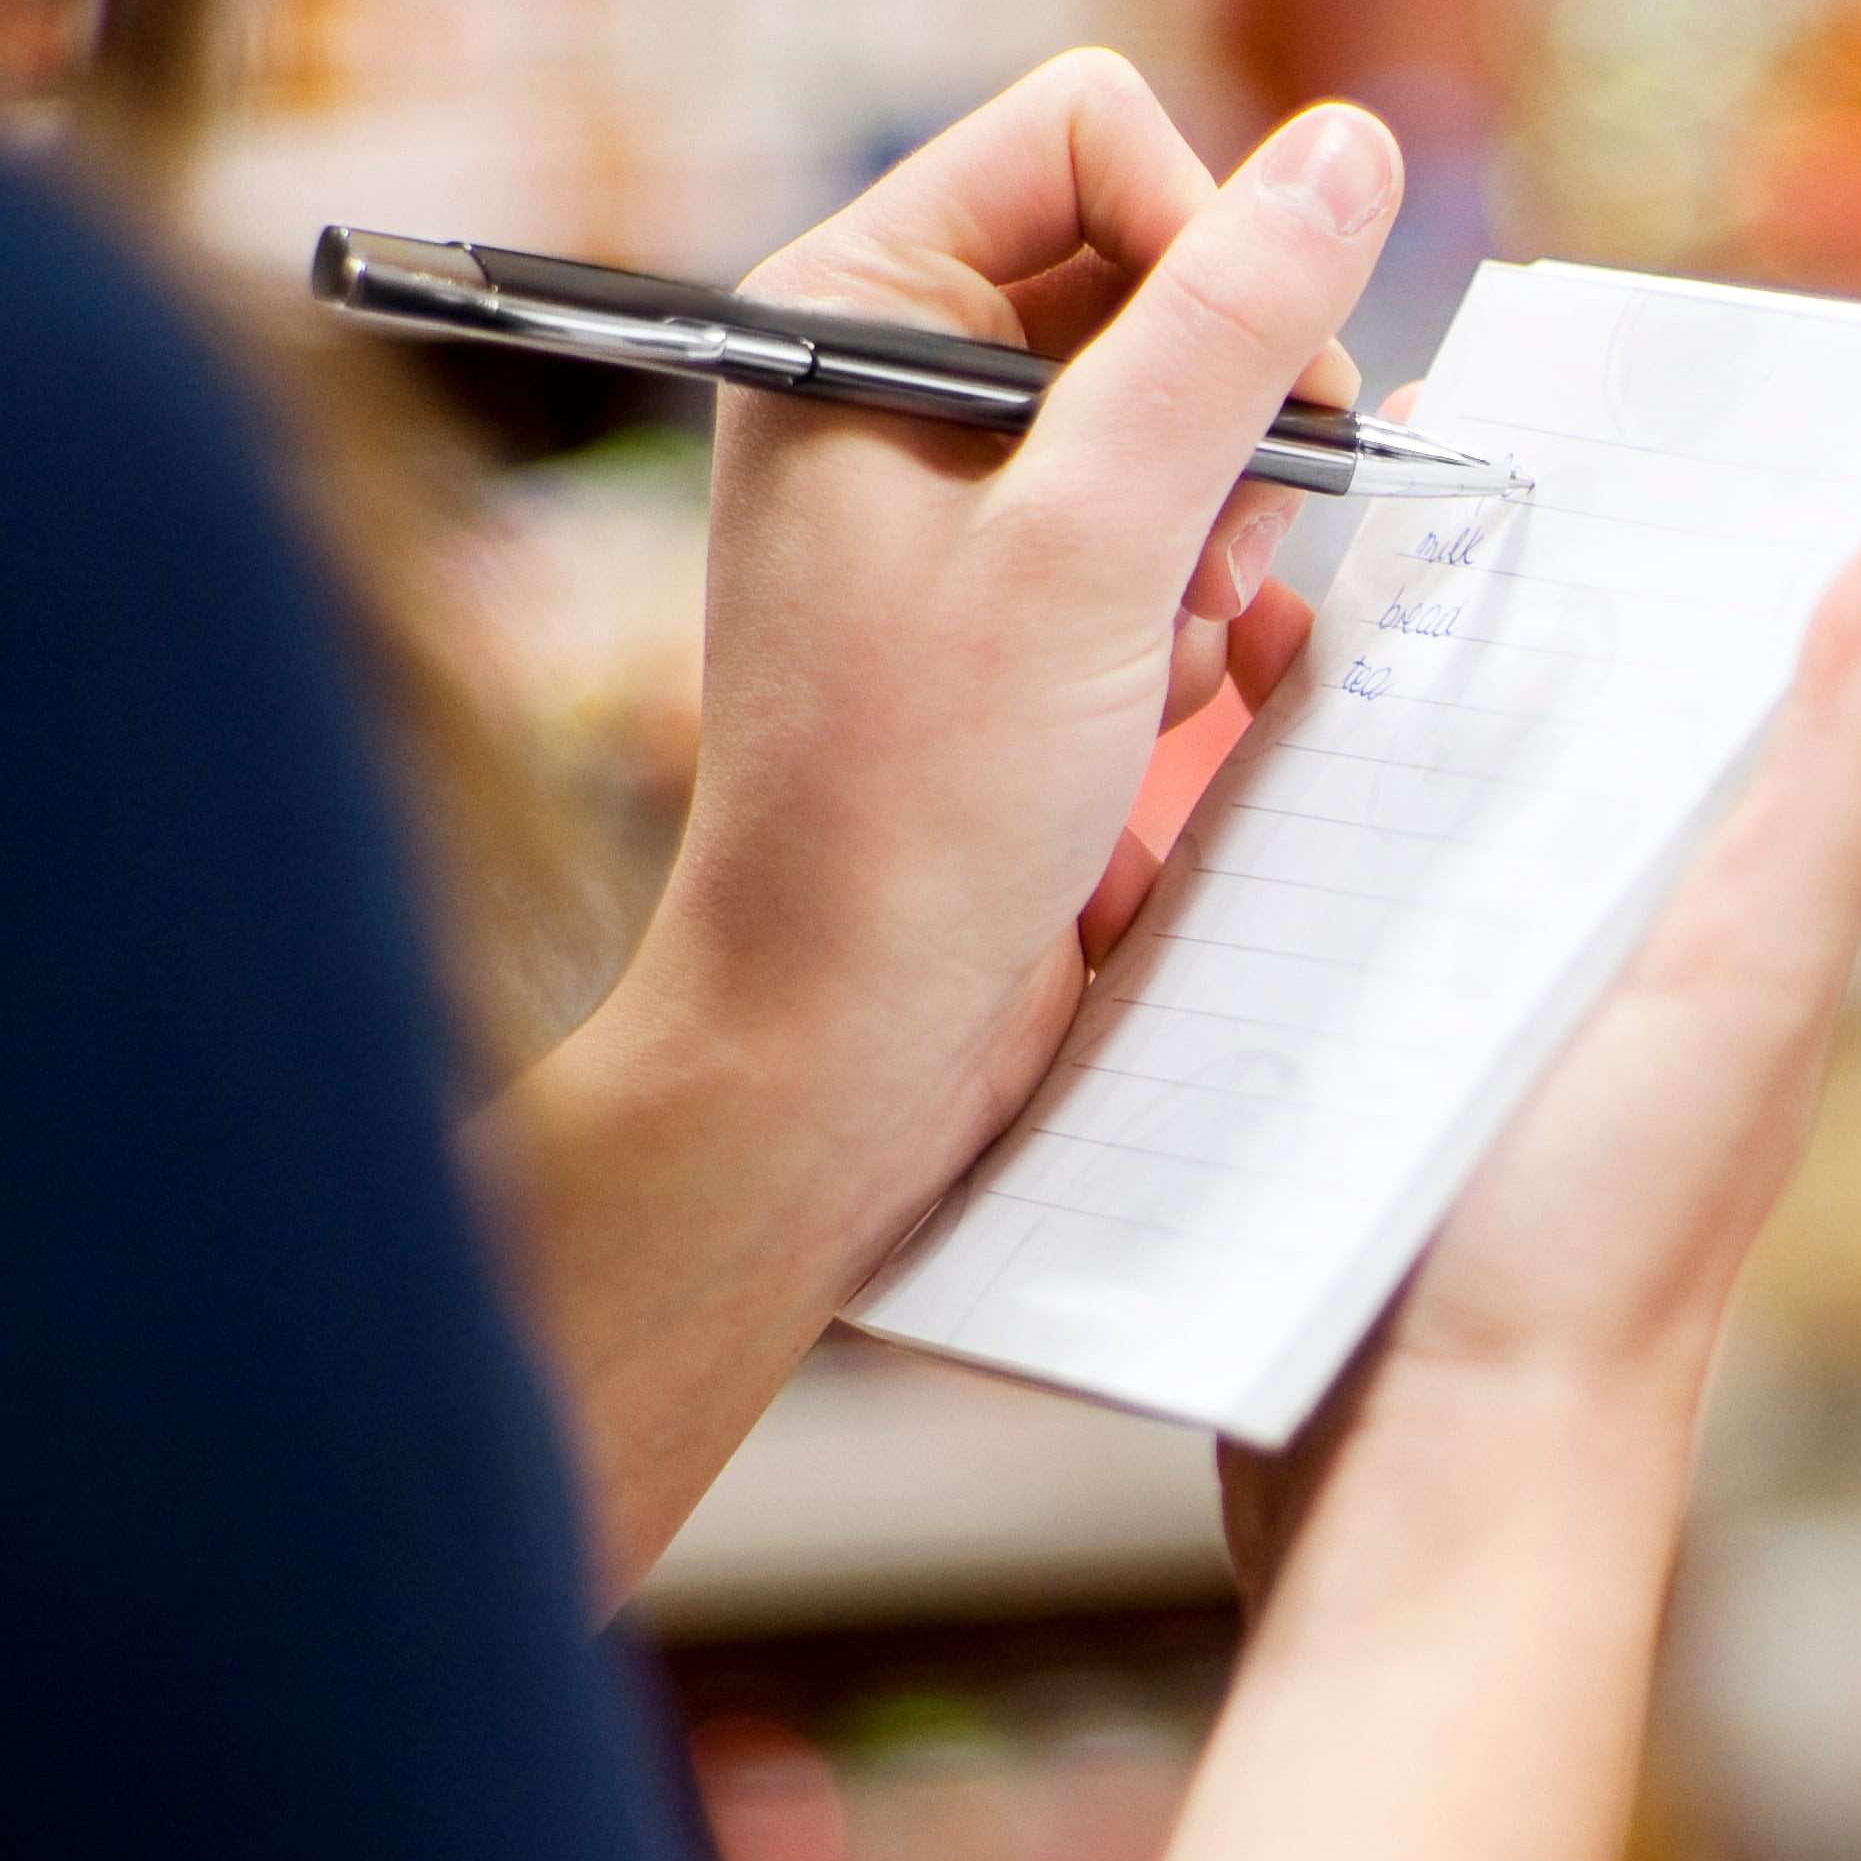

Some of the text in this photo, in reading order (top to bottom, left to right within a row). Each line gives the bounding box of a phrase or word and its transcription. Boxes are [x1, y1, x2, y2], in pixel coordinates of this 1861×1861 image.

[1415, 526, 1484, 566] milk
[1379, 586, 1465, 638] bread
[1342, 655, 1393, 701] tea
